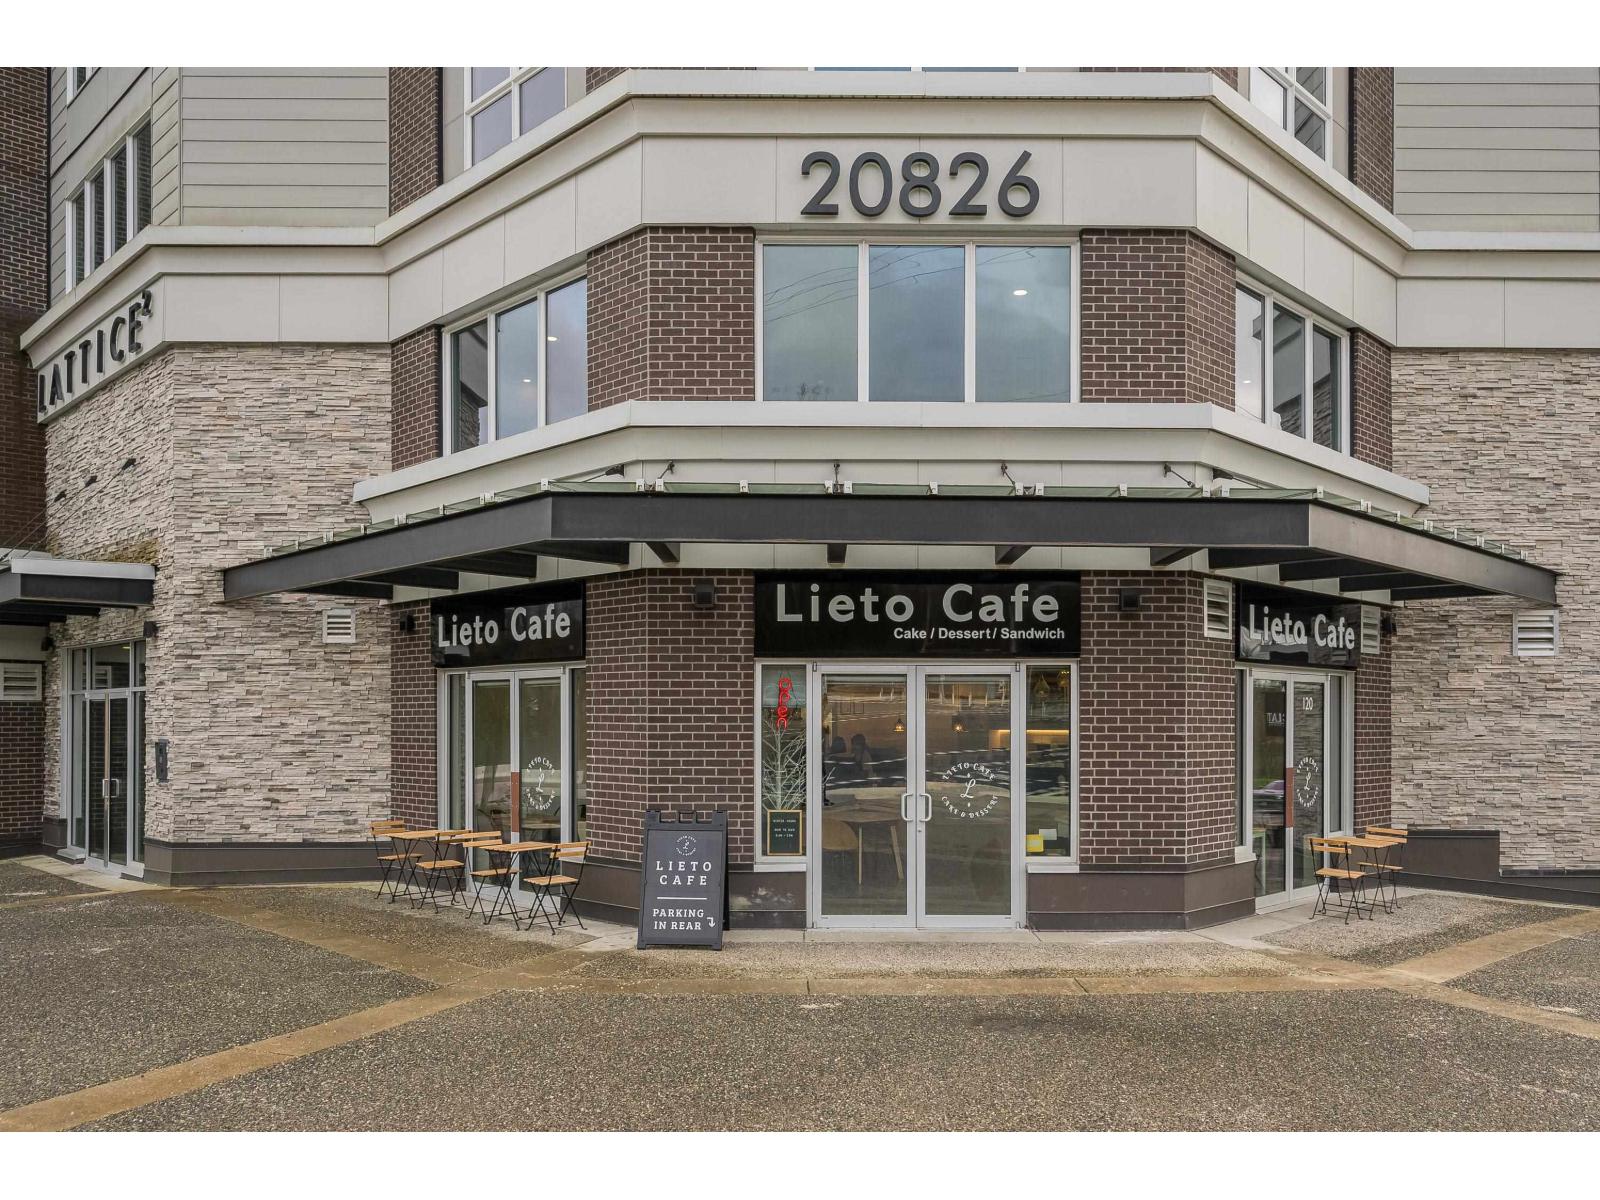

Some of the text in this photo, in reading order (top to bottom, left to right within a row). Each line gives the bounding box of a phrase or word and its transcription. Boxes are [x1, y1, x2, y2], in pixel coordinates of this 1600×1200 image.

[800, 150, 1040, 217] 20826
[777, 583, 1059, 622] Lieto Cafe
[438, 603, 571, 648] Lieto Cafe
[1249, 604, 1355, 650] Lieto Cafe
[893, 627, 927, 639] Cake
[1000, 627, 1065, 639] Sandwich
[1302, 696, 1314, 710] 120
[656, 861, 712, 871] LIETO
[660, 875, 707, 885] CAFE
[652, 908, 704, 918] PARKING
[654, 921, 702, 930] IN REAR
